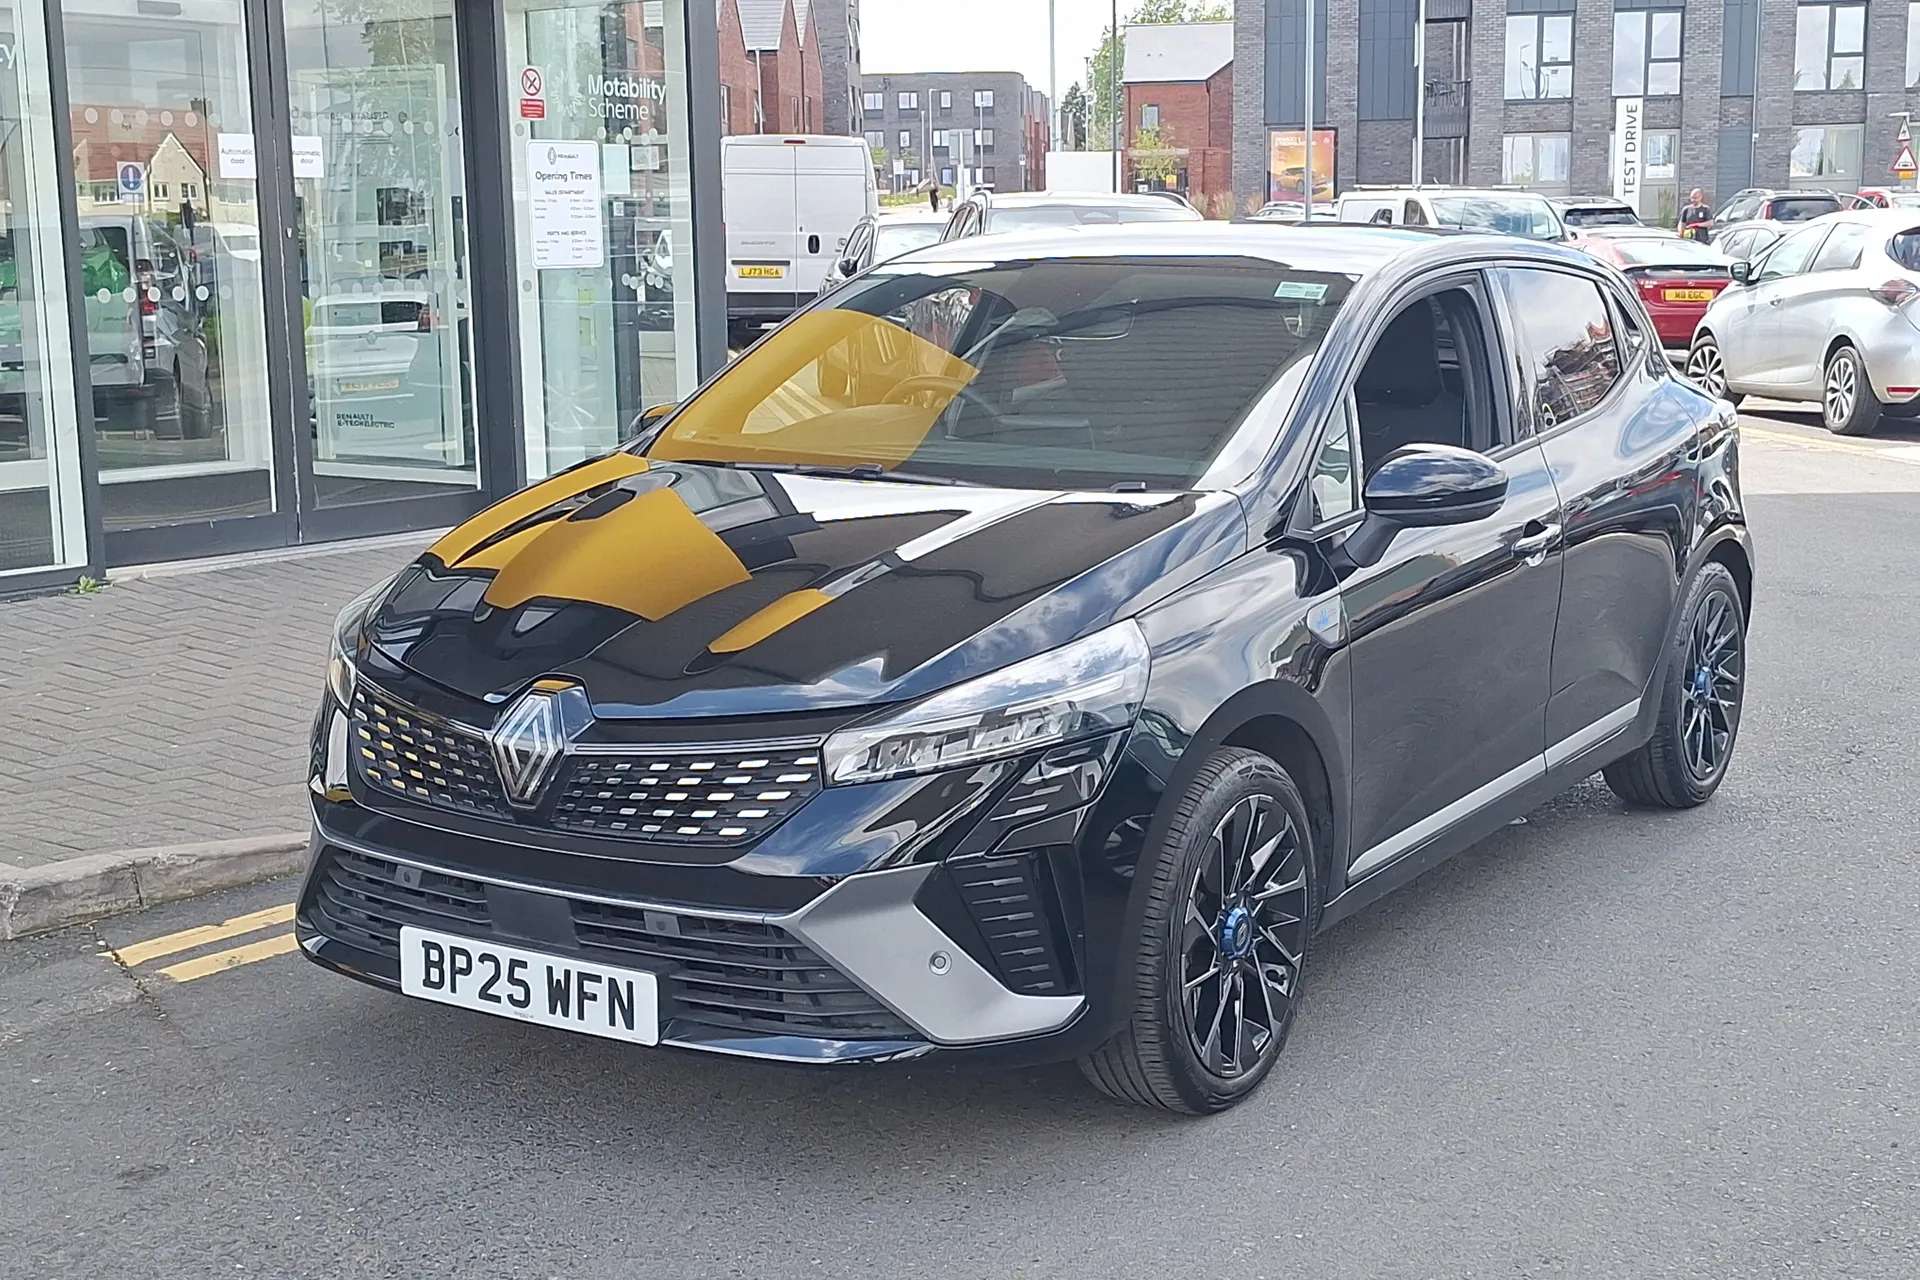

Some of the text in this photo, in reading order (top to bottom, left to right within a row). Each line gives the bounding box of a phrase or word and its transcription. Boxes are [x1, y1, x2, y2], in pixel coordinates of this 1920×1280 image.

[588, 74, 666, 104] Motability
[588, 97, 649, 120] Scheme
[1624, 104, 1638, 196] TEST DRIVE
[535, 170, 592, 182] Opening Times
[421, 939, 635, 1031] BP25 WFN
